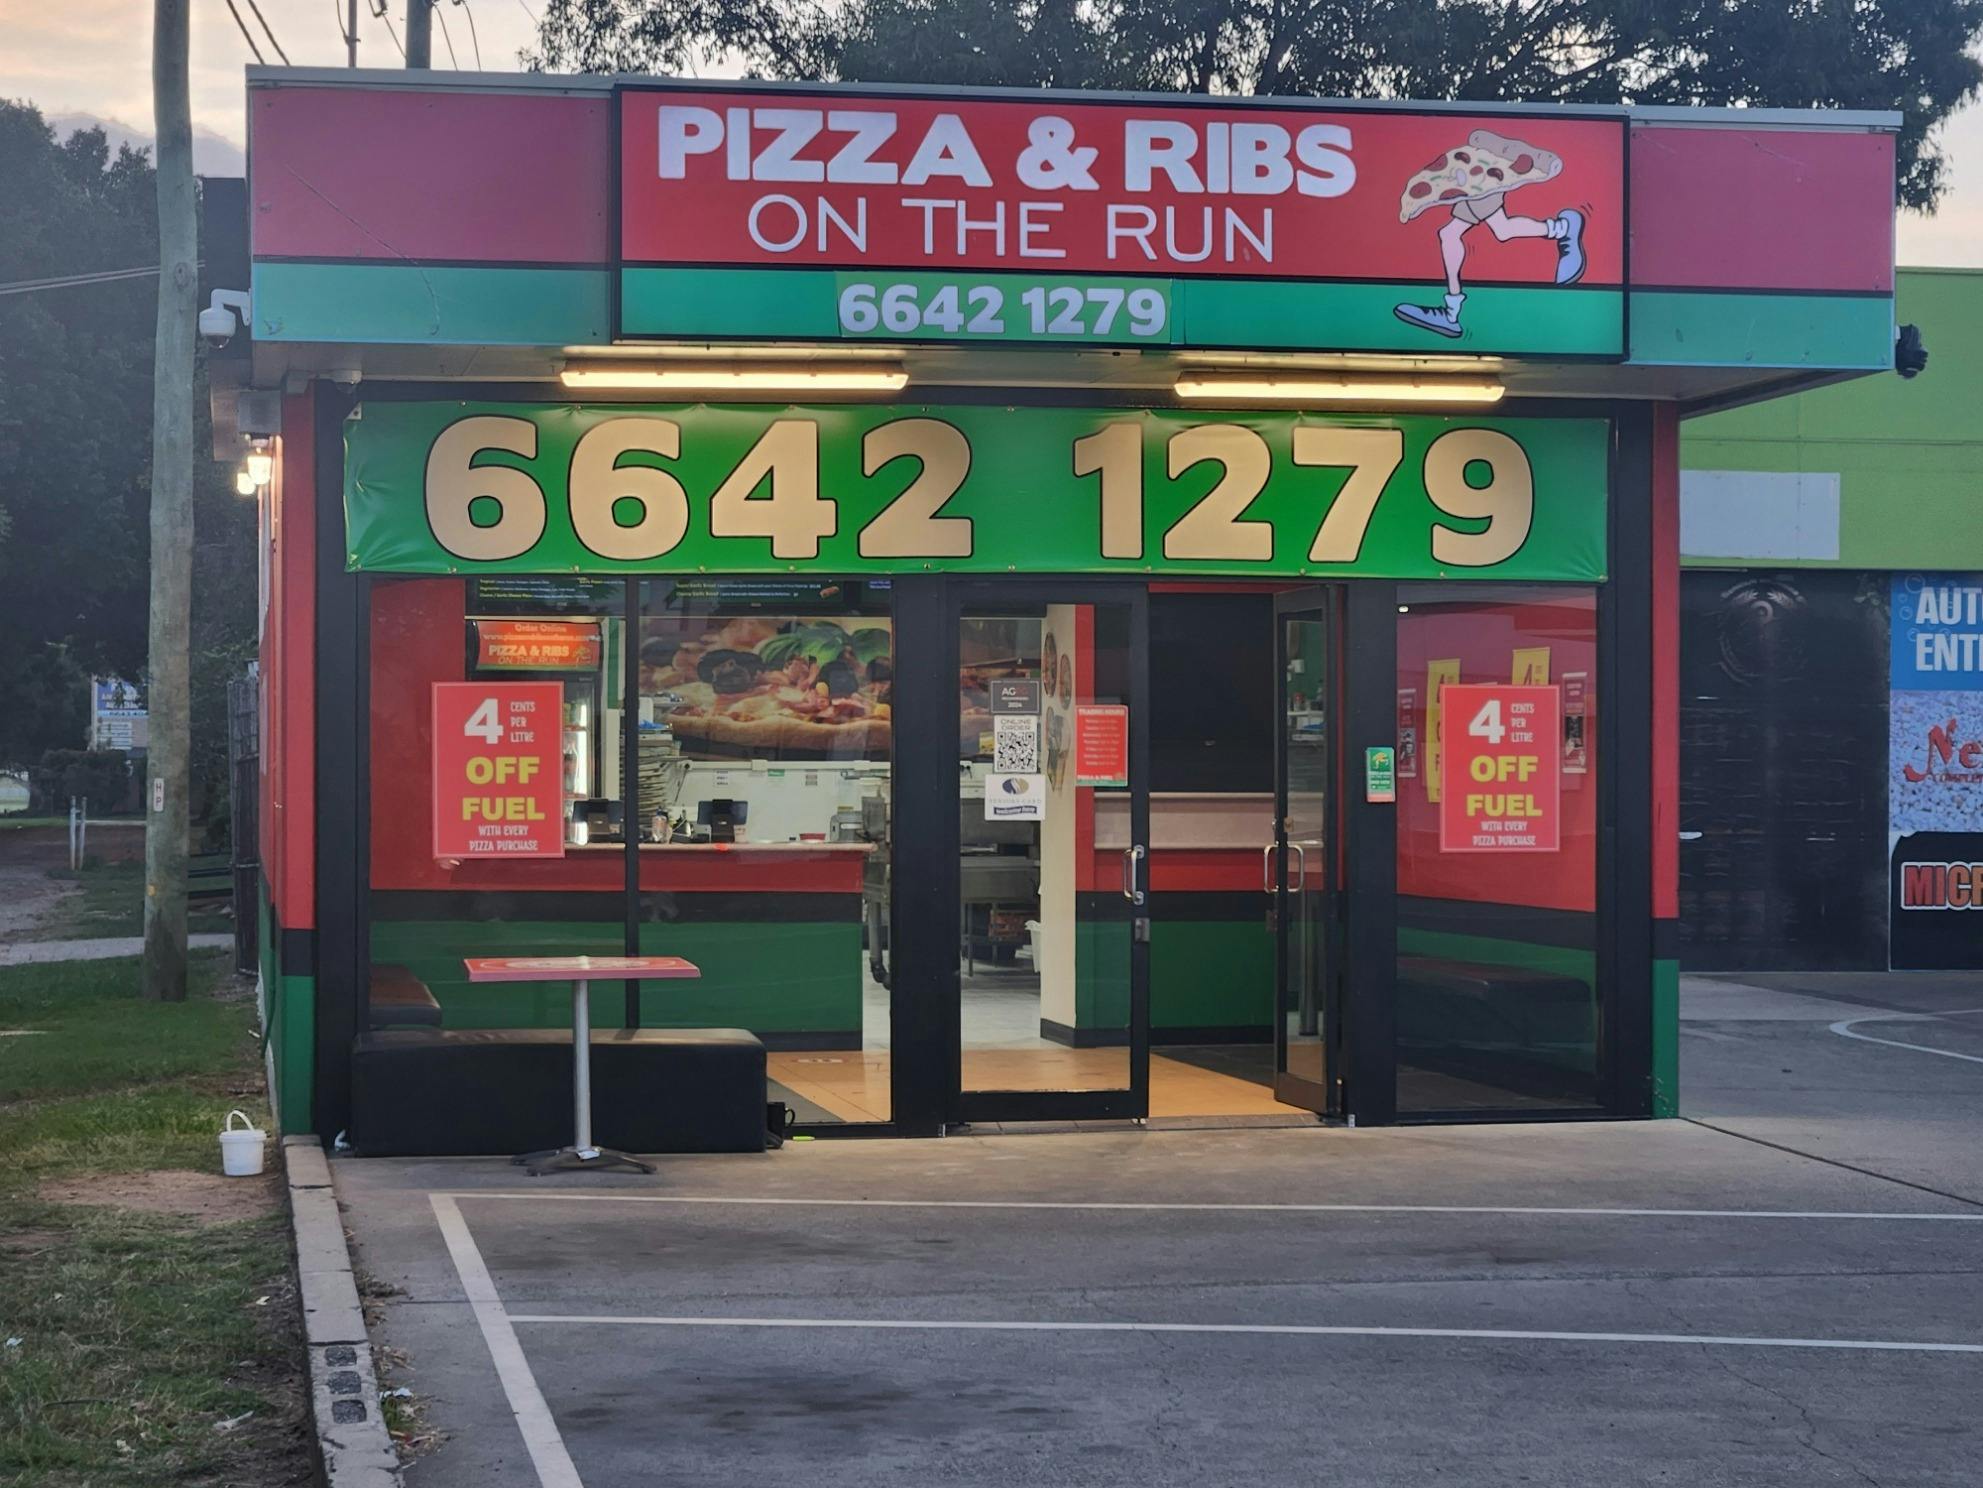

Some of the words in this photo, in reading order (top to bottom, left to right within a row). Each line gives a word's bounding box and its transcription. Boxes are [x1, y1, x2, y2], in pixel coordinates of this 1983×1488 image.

[658, 105, 993, 187] PIZZA
[1016, 115, 1100, 190] &
[1125, 119, 1357, 198] RIBS
[748, 194, 866, 253] ON
[902, 198, 1067, 258] THE
[1107, 204, 1273, 263] RUN
[839, 283, 1004, 333] 6642
[1022, 287, 1166, 336] 1279
[425, 414, 973, 561] 6642
[1073, 422, 1535, 568] 1279
[1915, 586, 1983, 625] AUT
[488, 644, 528, 656] PIZZA
[529, 645, 540, 656] &
[541, 645, 570, 657] RIBS
[510, 701, 536, 713] CENTS
[1511, 703, 1535, 714] CENTS
[464, 698, 504, 744] 4
[510, 716, 527, 728] PER
[1468, 699, 1505, 744] 4
[1511, 717, 1526, 728] PER
[510, 731, 535, 743] LITRE
[1903, 716, 1983, 782] Ne
[466, 756, 540, 785] OFF
[1470, 755, 1538, 782] OFF
[462, 797, 545, 821] FUEL
[1466, 794, 1543, 817] FUEL
[478, 825, 502, 837] WITH
[1472, 836, 1496, 846] PIZZA
[1498, 836, 1536, 846] PURCHASE
[469, 840, 495, 851] PIZZA
[496, 840, 539, 851] PURCHASE
